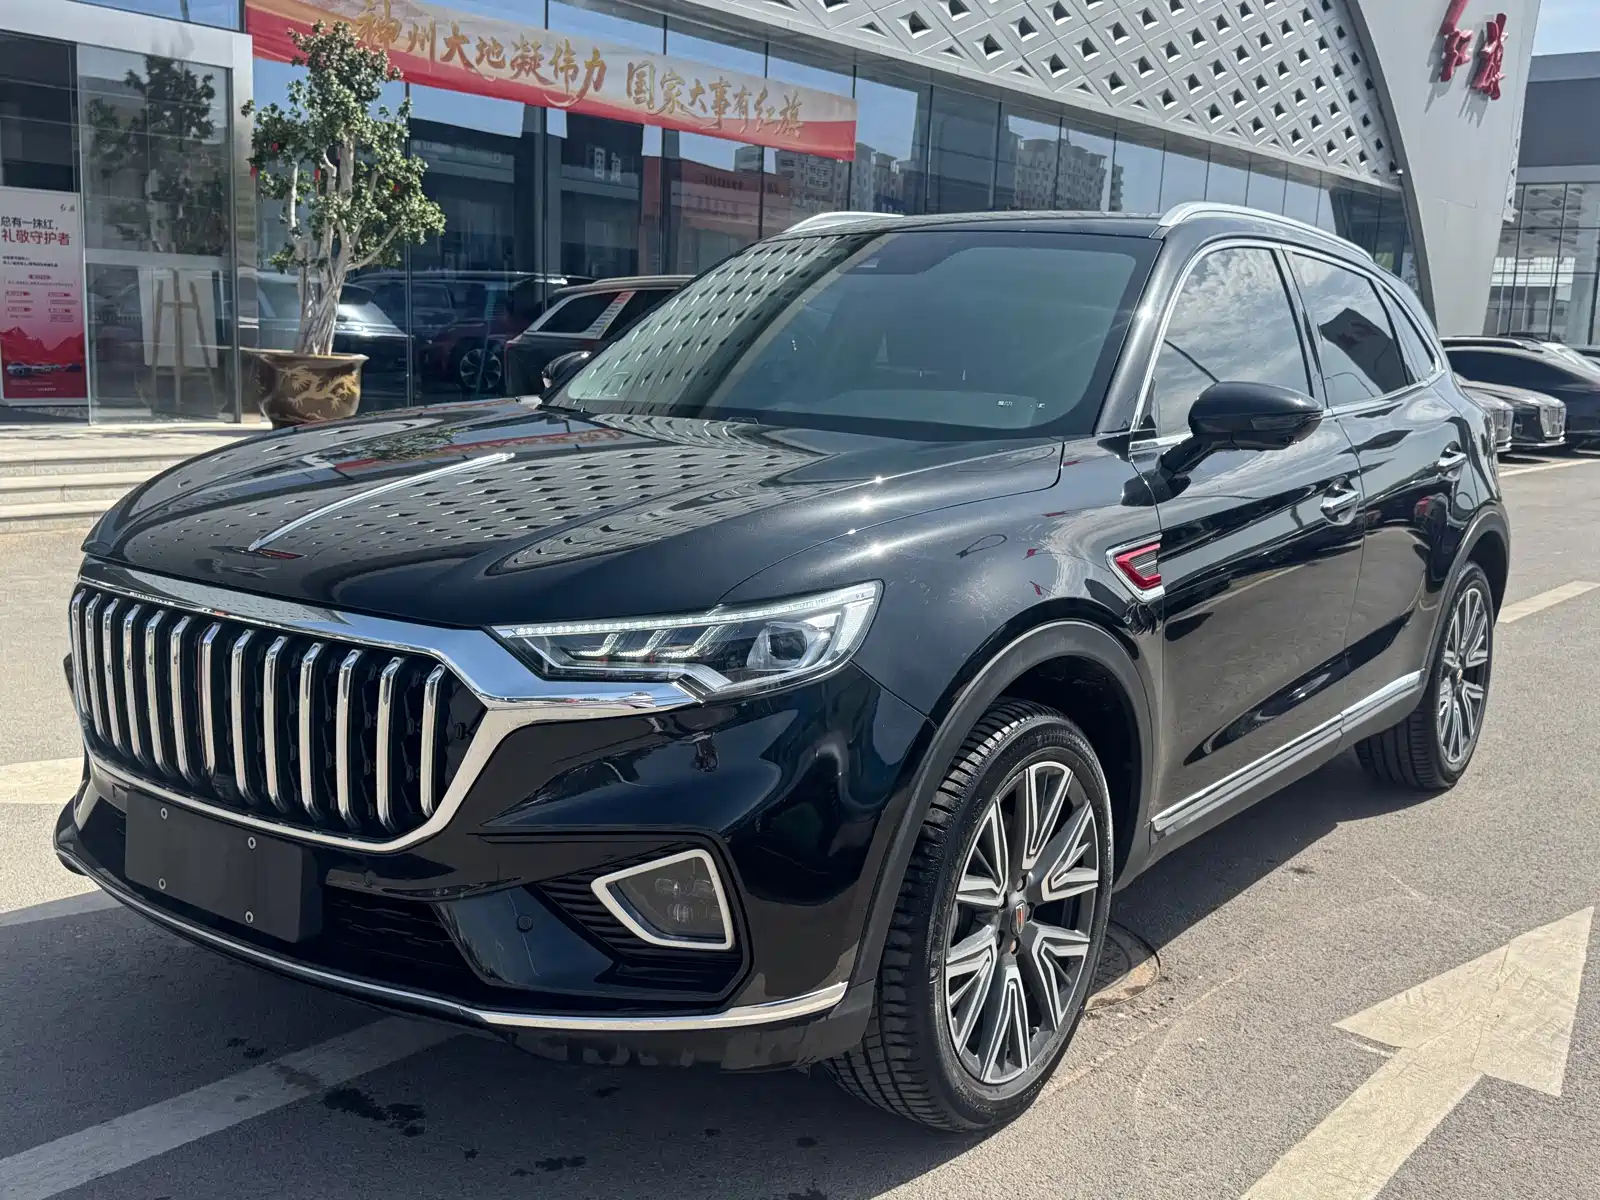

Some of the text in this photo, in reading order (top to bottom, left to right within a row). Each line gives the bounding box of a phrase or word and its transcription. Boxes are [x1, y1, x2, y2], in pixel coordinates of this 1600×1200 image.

[625, 60, 804, 139] 国家大事有红旗
[1, 228, 71, 246] 礼敬守护者
